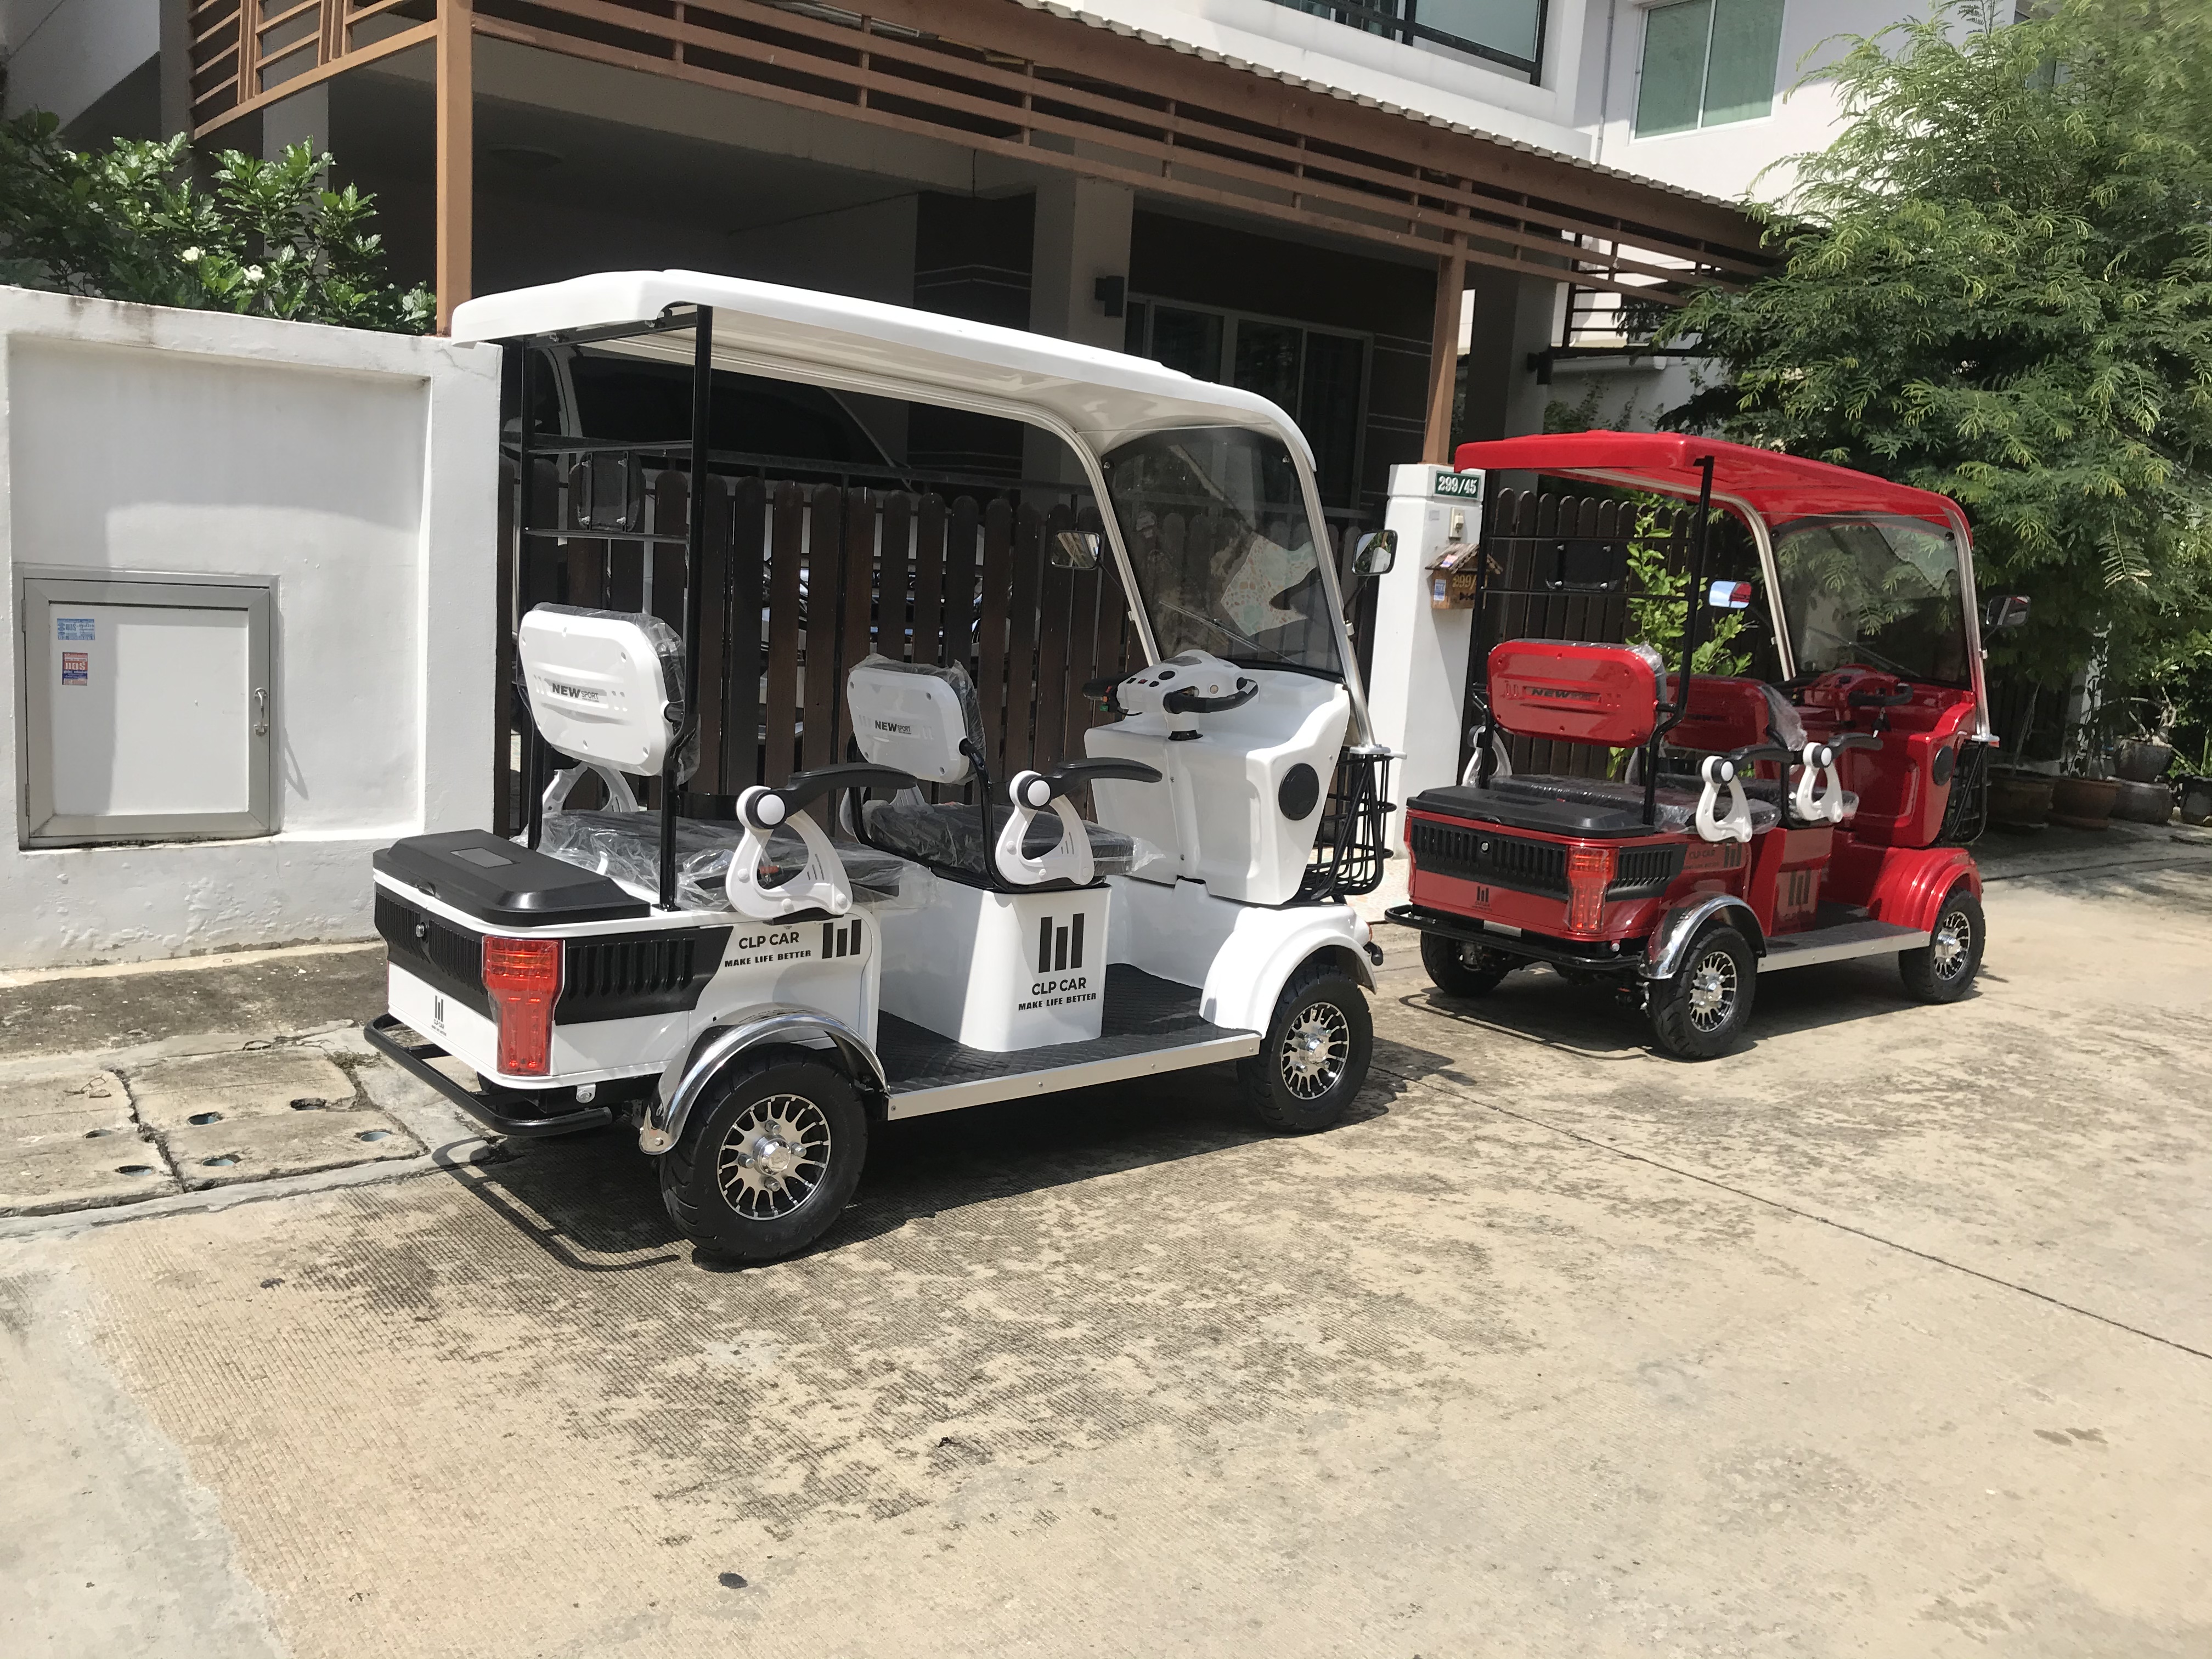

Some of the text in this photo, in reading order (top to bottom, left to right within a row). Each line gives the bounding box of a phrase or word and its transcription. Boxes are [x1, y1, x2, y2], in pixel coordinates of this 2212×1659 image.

[1438, 476, 1477, 494] 299/45
[1452, 574, 1477, 590] 299/
[552, 683, 599, 699] NEW SPORT
[1531, 689, 1570, 698] NEW
[875, 720, 897, 732] NEW
[738, 932, 799, 949] CLP CAR
[725, 950, 811, 967] MAKE LIFE BETTER
[1032, 977, 1086, 995] CLP CAR
[1018, 992, 1096, 1011] MAKE LIFE BETTER
